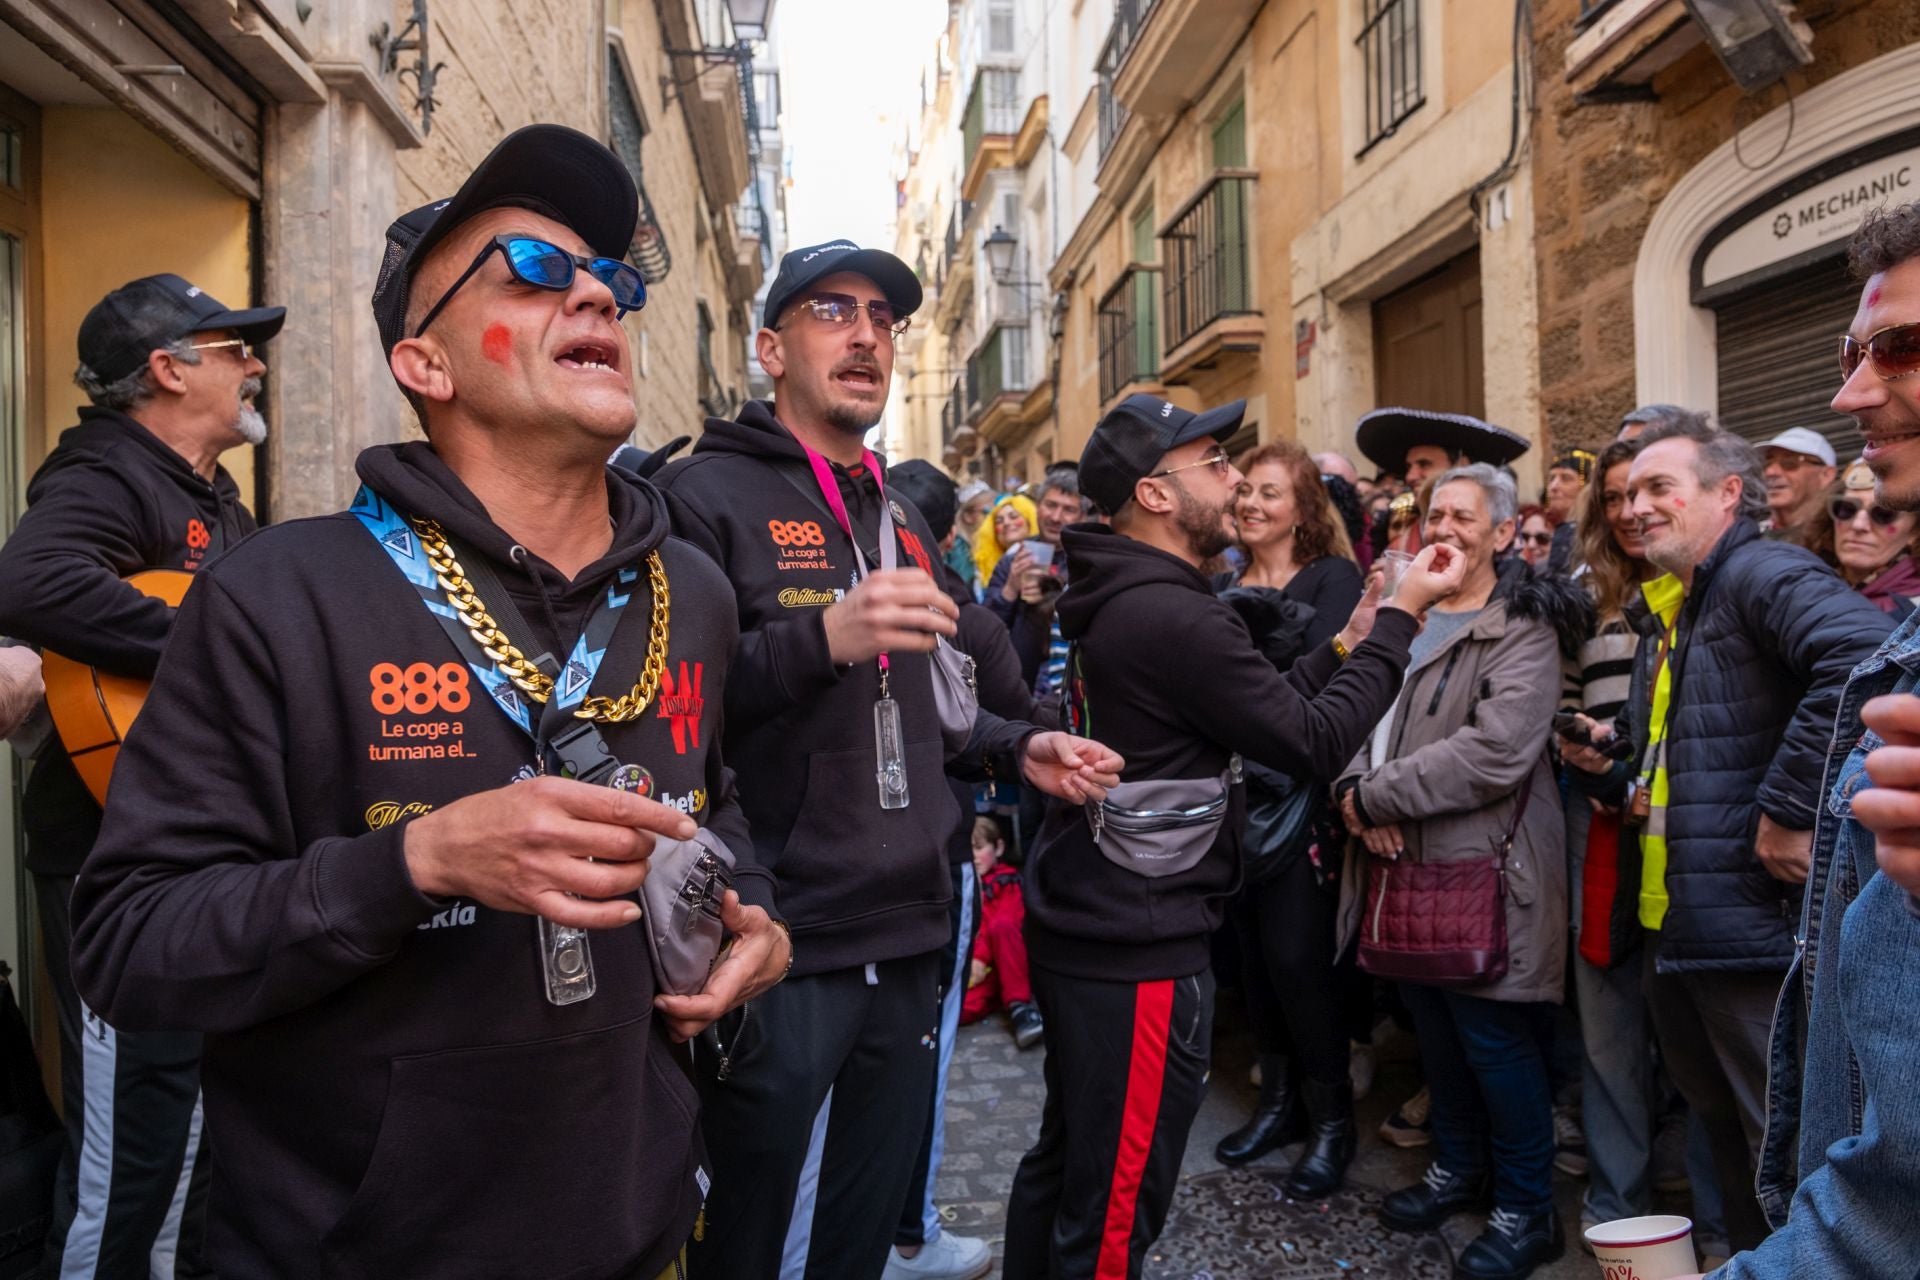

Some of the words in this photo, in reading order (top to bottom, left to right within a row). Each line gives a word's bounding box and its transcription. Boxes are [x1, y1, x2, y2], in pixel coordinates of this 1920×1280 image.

[1798, 166, 1911, 227] MECHANIC
[768, 519, 825, 547] 888
[781, 547, 795, 557] Le
[795, 549, 817, 559] coge
[818, 549, 825, 557] a
[778, 587, 835, 608] William
[369, 662, 471, 715] 888
[381, 719, 404, 737] Le
[407, 721, 449, 740] coge
[451, 721, 464, 735] a
[369, 744, 445, 761] turmana
[447, 740, 465, 758] el
